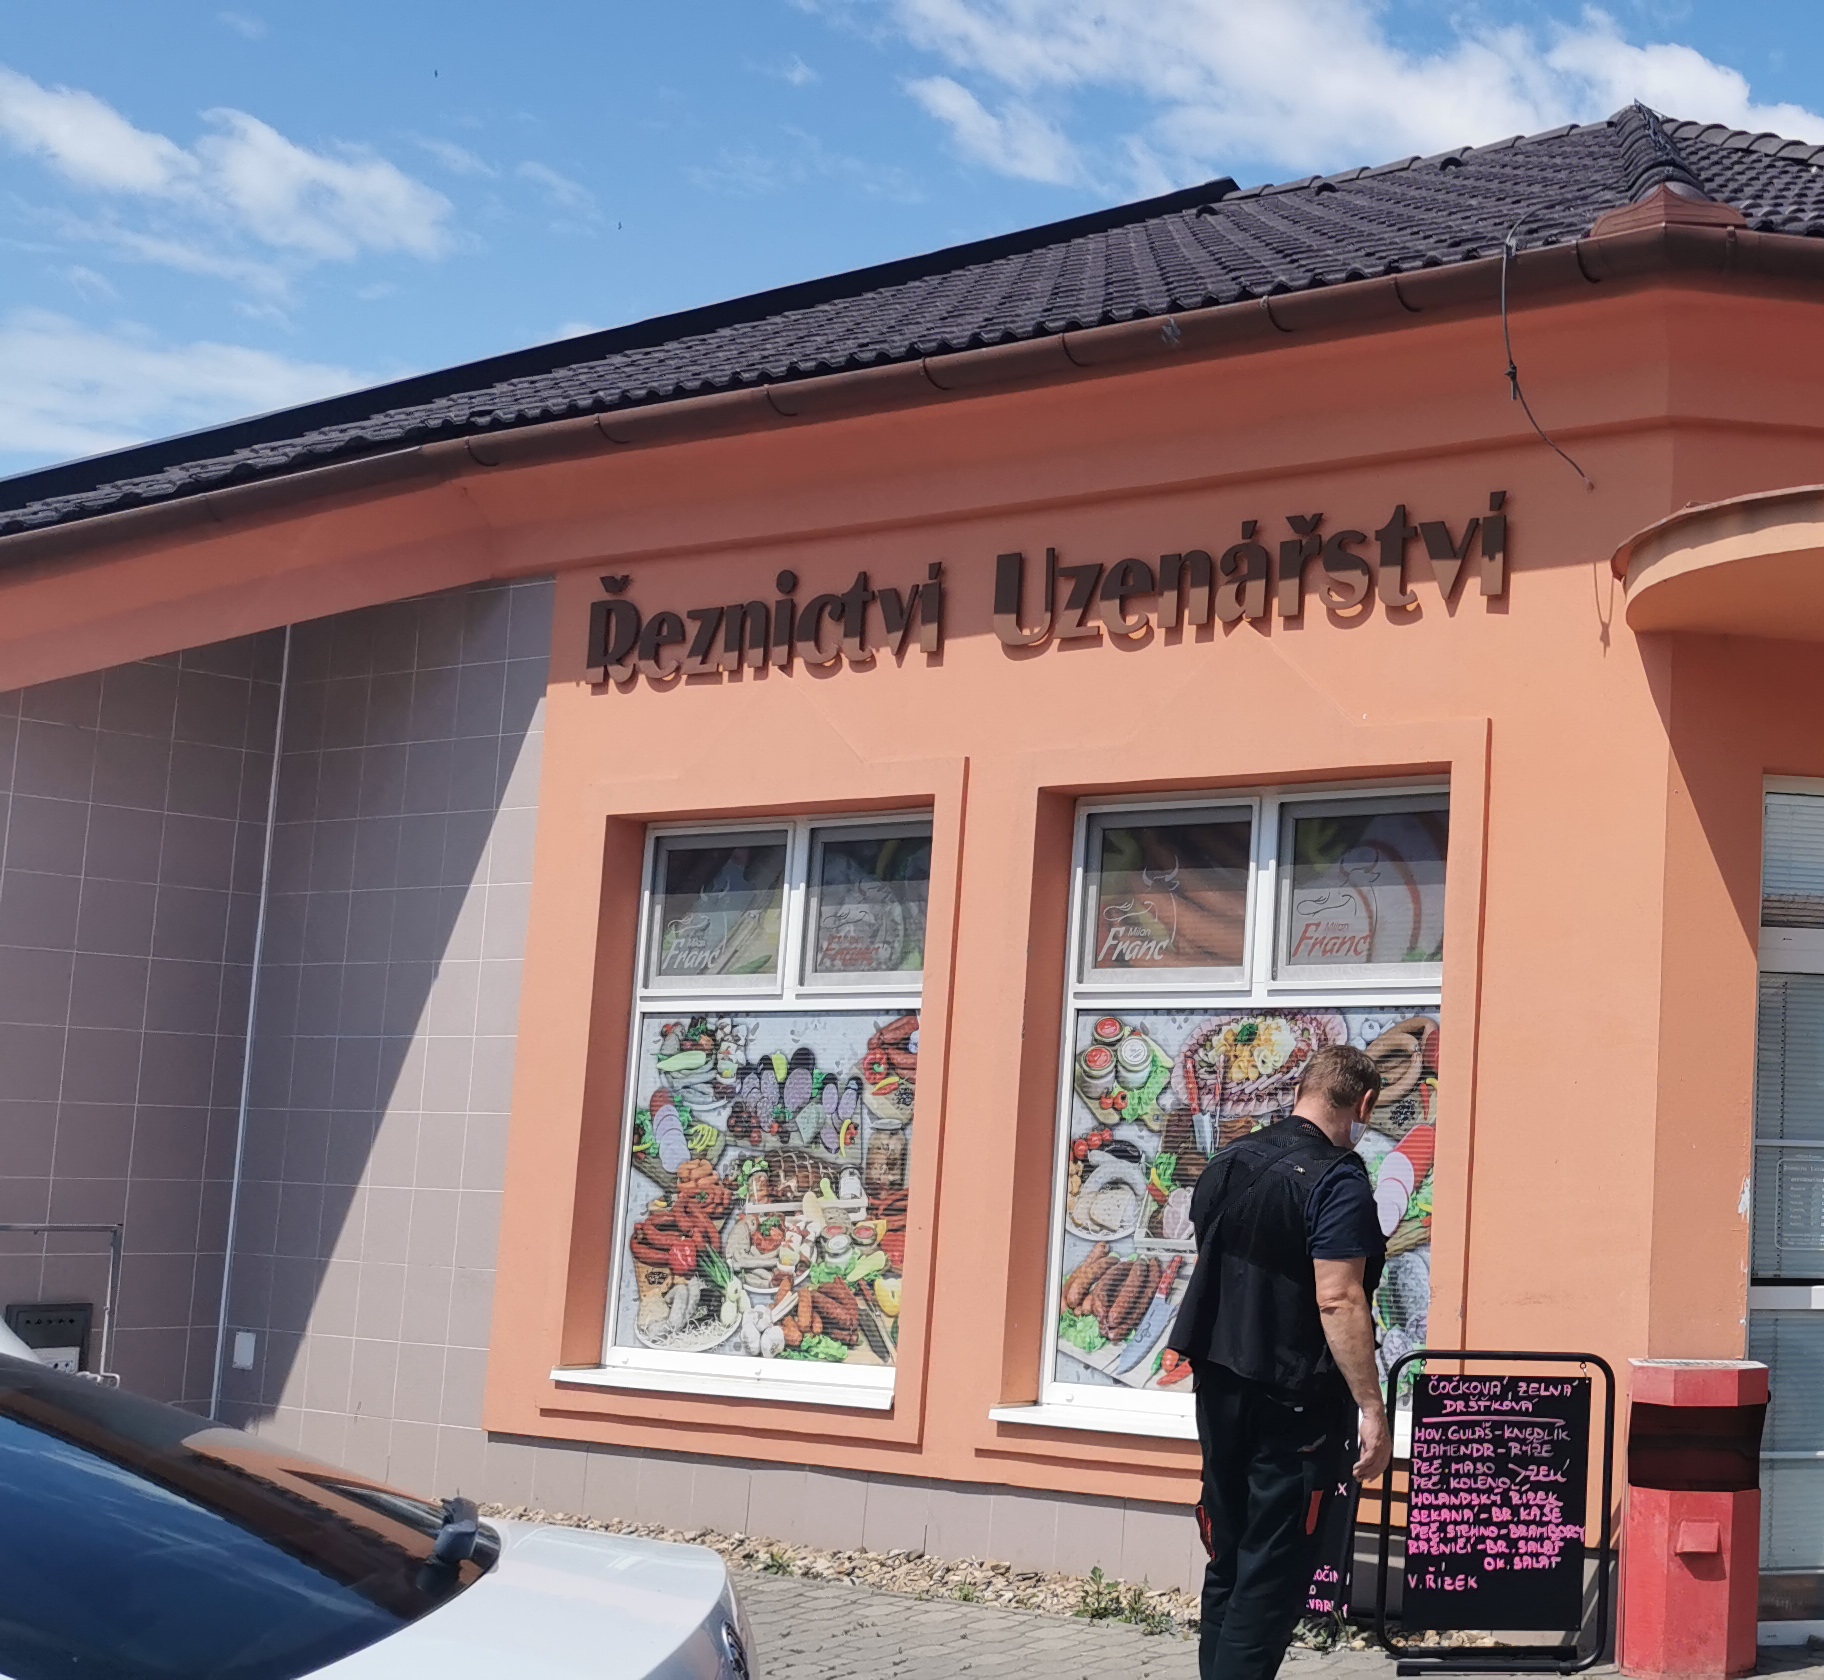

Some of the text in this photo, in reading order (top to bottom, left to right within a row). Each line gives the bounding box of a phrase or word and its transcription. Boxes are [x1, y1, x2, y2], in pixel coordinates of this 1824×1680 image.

[586, 490, 1508, 685] Řeznictví Uzenářství
[661, 939, 721, 970] Franc
[1098, 926, 1171, 961] Franc
[1291, 921, 1372, 958] Franc
[1450, 1475, 1512, 1490] KOLENO
[1451, 1461, 1496, 1475] MASO
